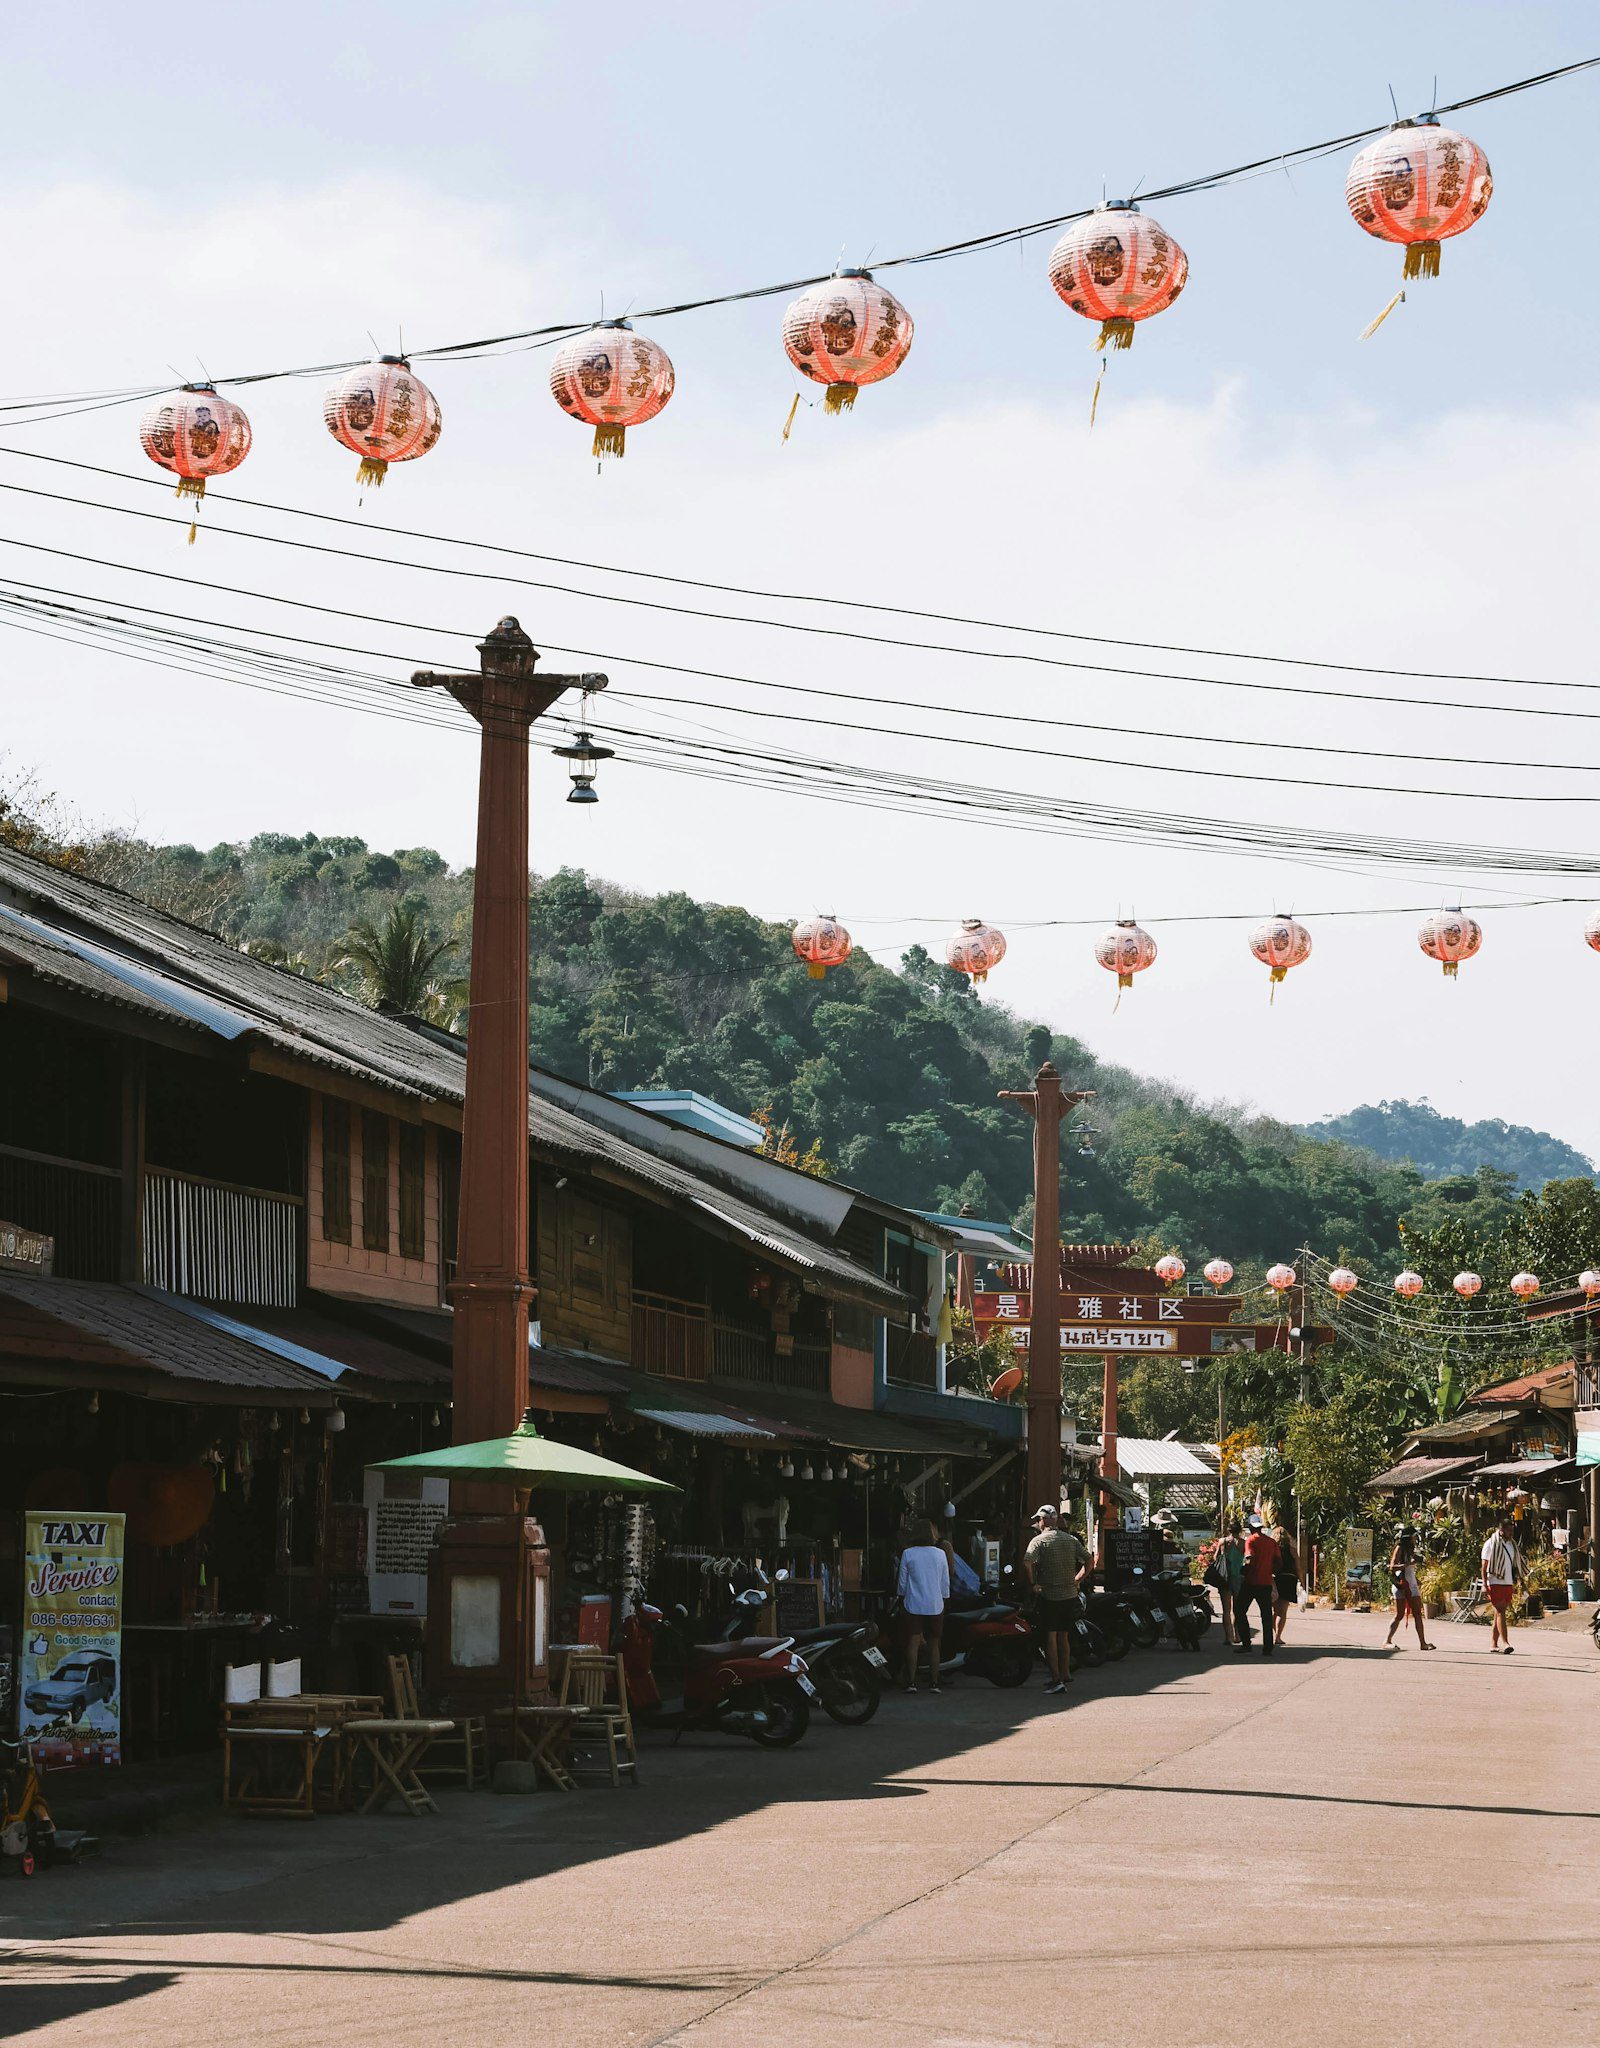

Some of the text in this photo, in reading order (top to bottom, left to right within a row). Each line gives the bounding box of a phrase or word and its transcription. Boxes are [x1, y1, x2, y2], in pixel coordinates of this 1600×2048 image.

[995, 1294, 1184, 1321] 是雅社区
[42, 1521, 108, 1546] TAXI
[29, 1561, 119, 1597] Service
[79, 1594, 116, 1606] contact
[32, 1613, 115, 1627] 086-6979631
[55, 1634, 116, 1646] Good Service
